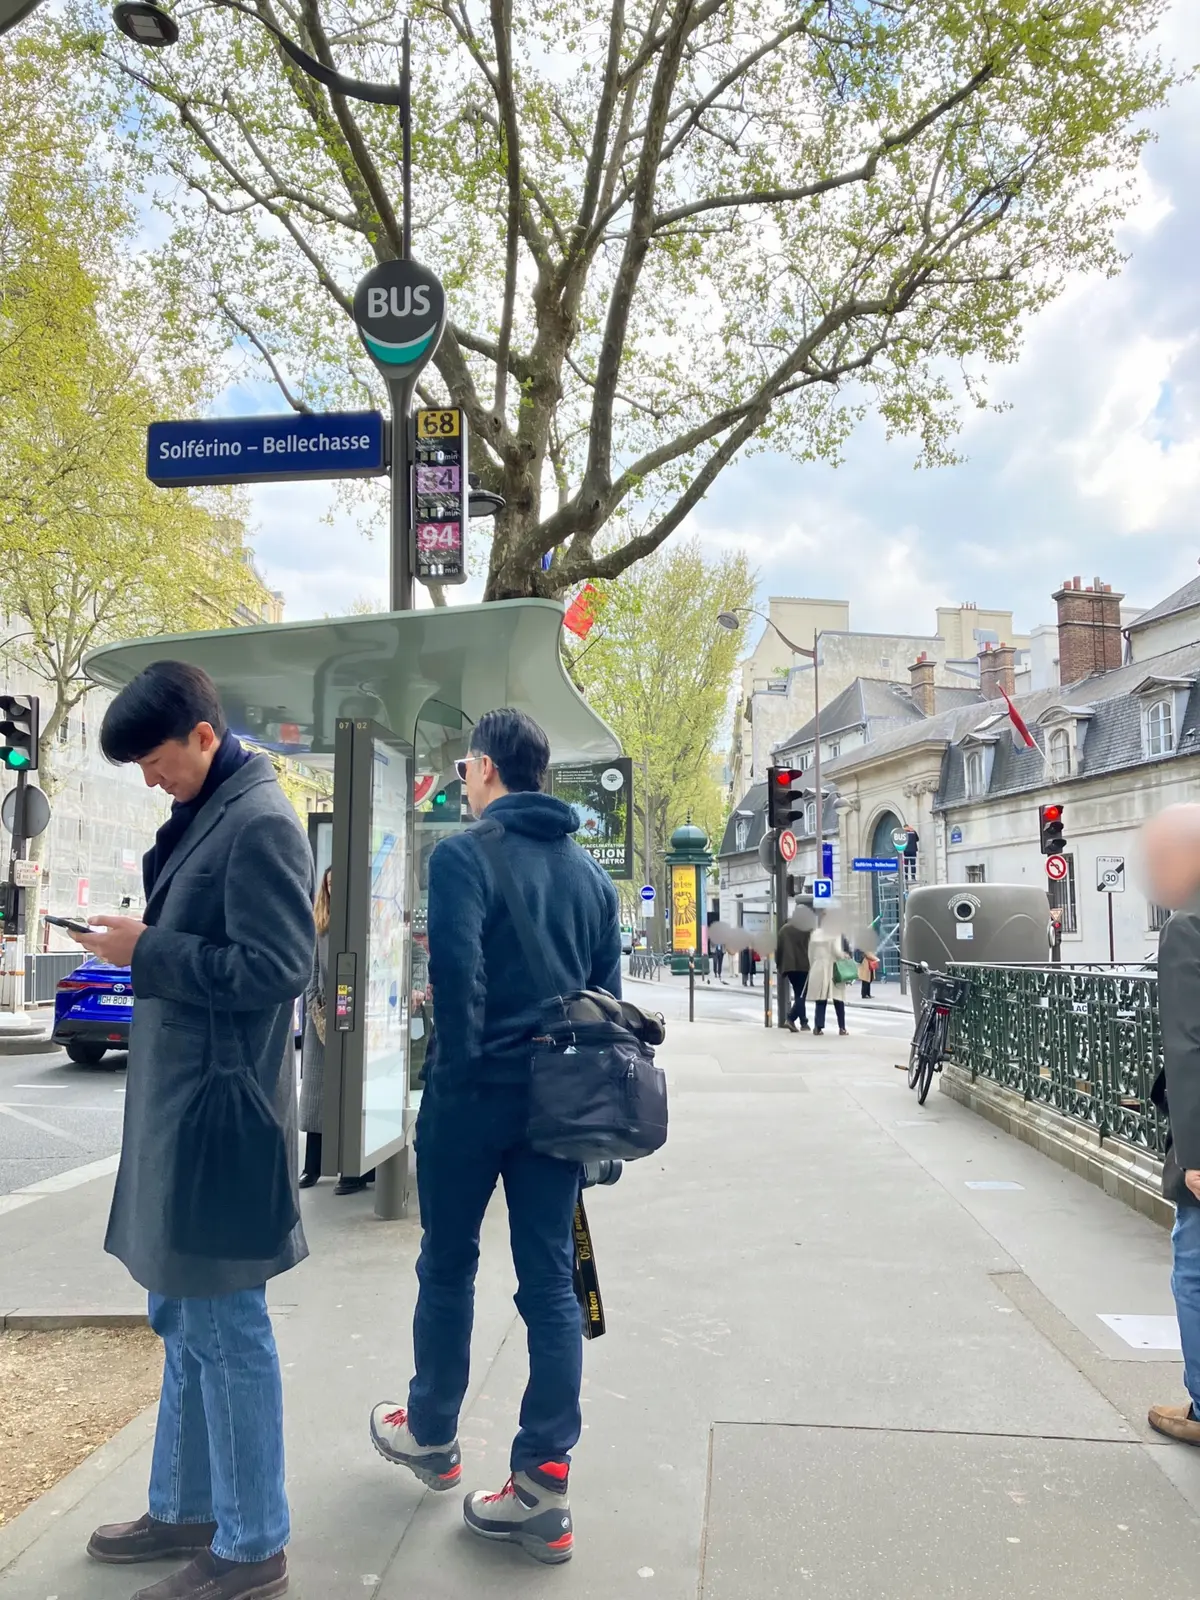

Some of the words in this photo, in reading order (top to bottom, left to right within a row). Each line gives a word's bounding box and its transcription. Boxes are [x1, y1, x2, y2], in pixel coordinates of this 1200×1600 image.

[367, 284, 431, 319] BUS
[424, 412, 454, 434] 68
[159, 438, 242, 460] Solférino
[263, 432, 371, 454] Bellechasse
[422, 525, 454, 548] 94
[894, 832, 906, 841] BUS
[818, 882, 828, 896] P
[1106, 874, 1116, 882] 30
[589, 1292, 600, 1321] Nikon
